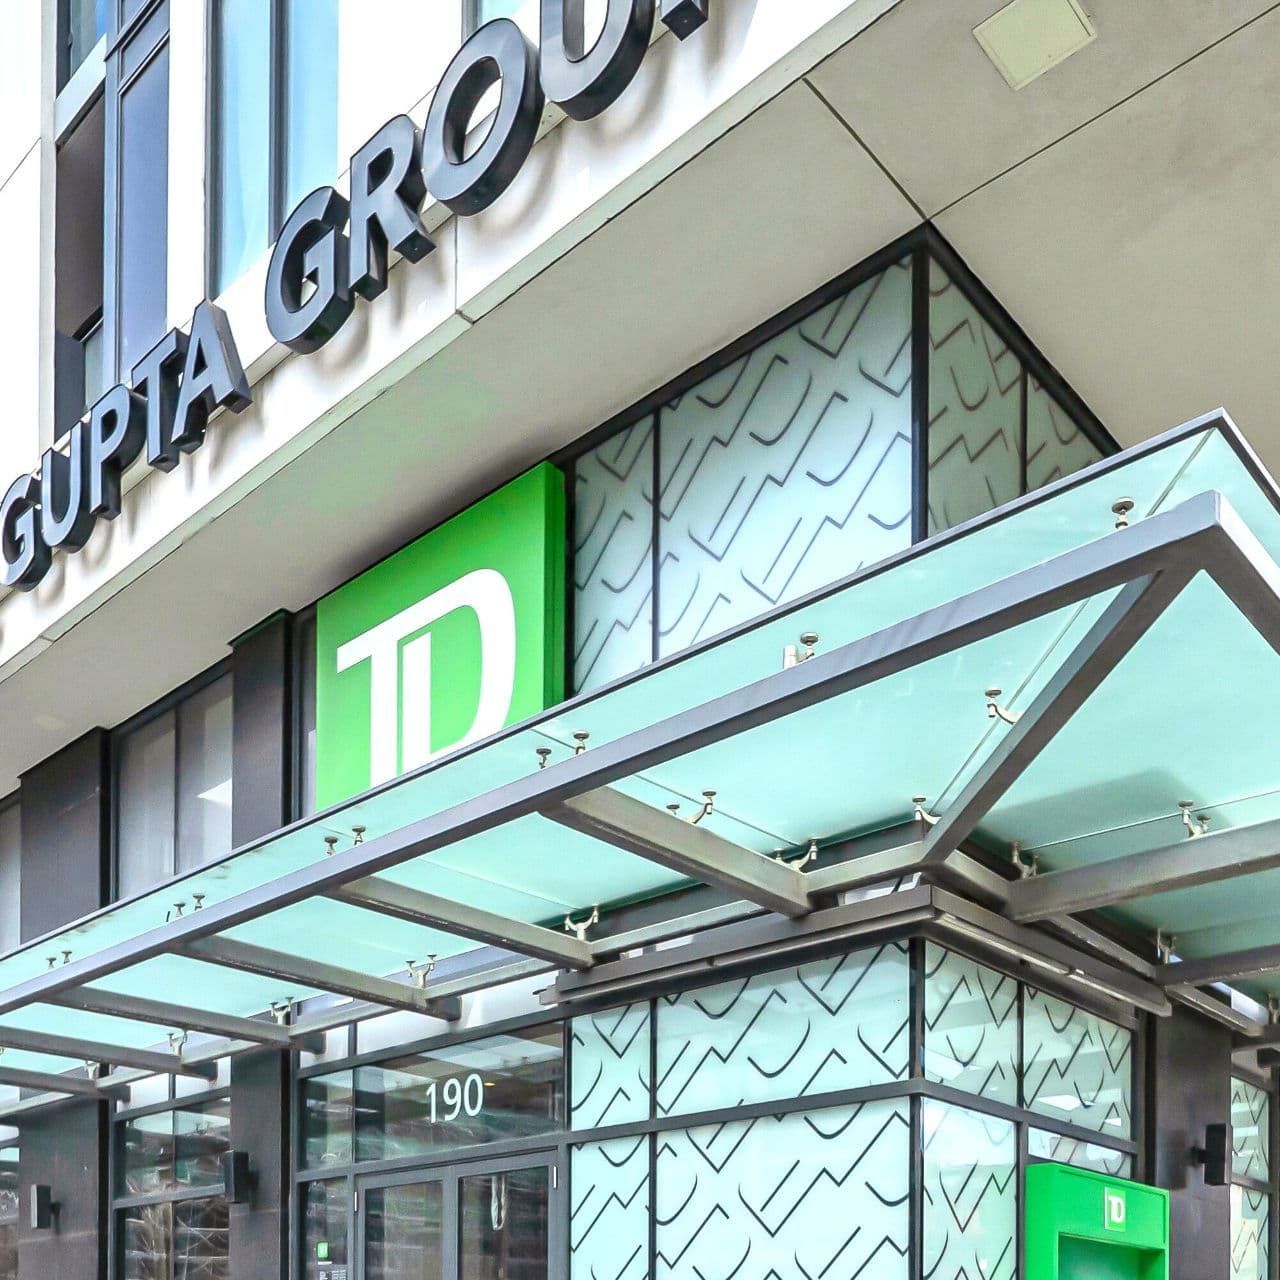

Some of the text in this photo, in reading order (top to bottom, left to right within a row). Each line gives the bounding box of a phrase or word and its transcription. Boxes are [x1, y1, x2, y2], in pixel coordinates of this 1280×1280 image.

[265, 0, 708, 355] GROU
[337, 567, 516, 788] TD
[425, 1073, 484, 1124] 190
